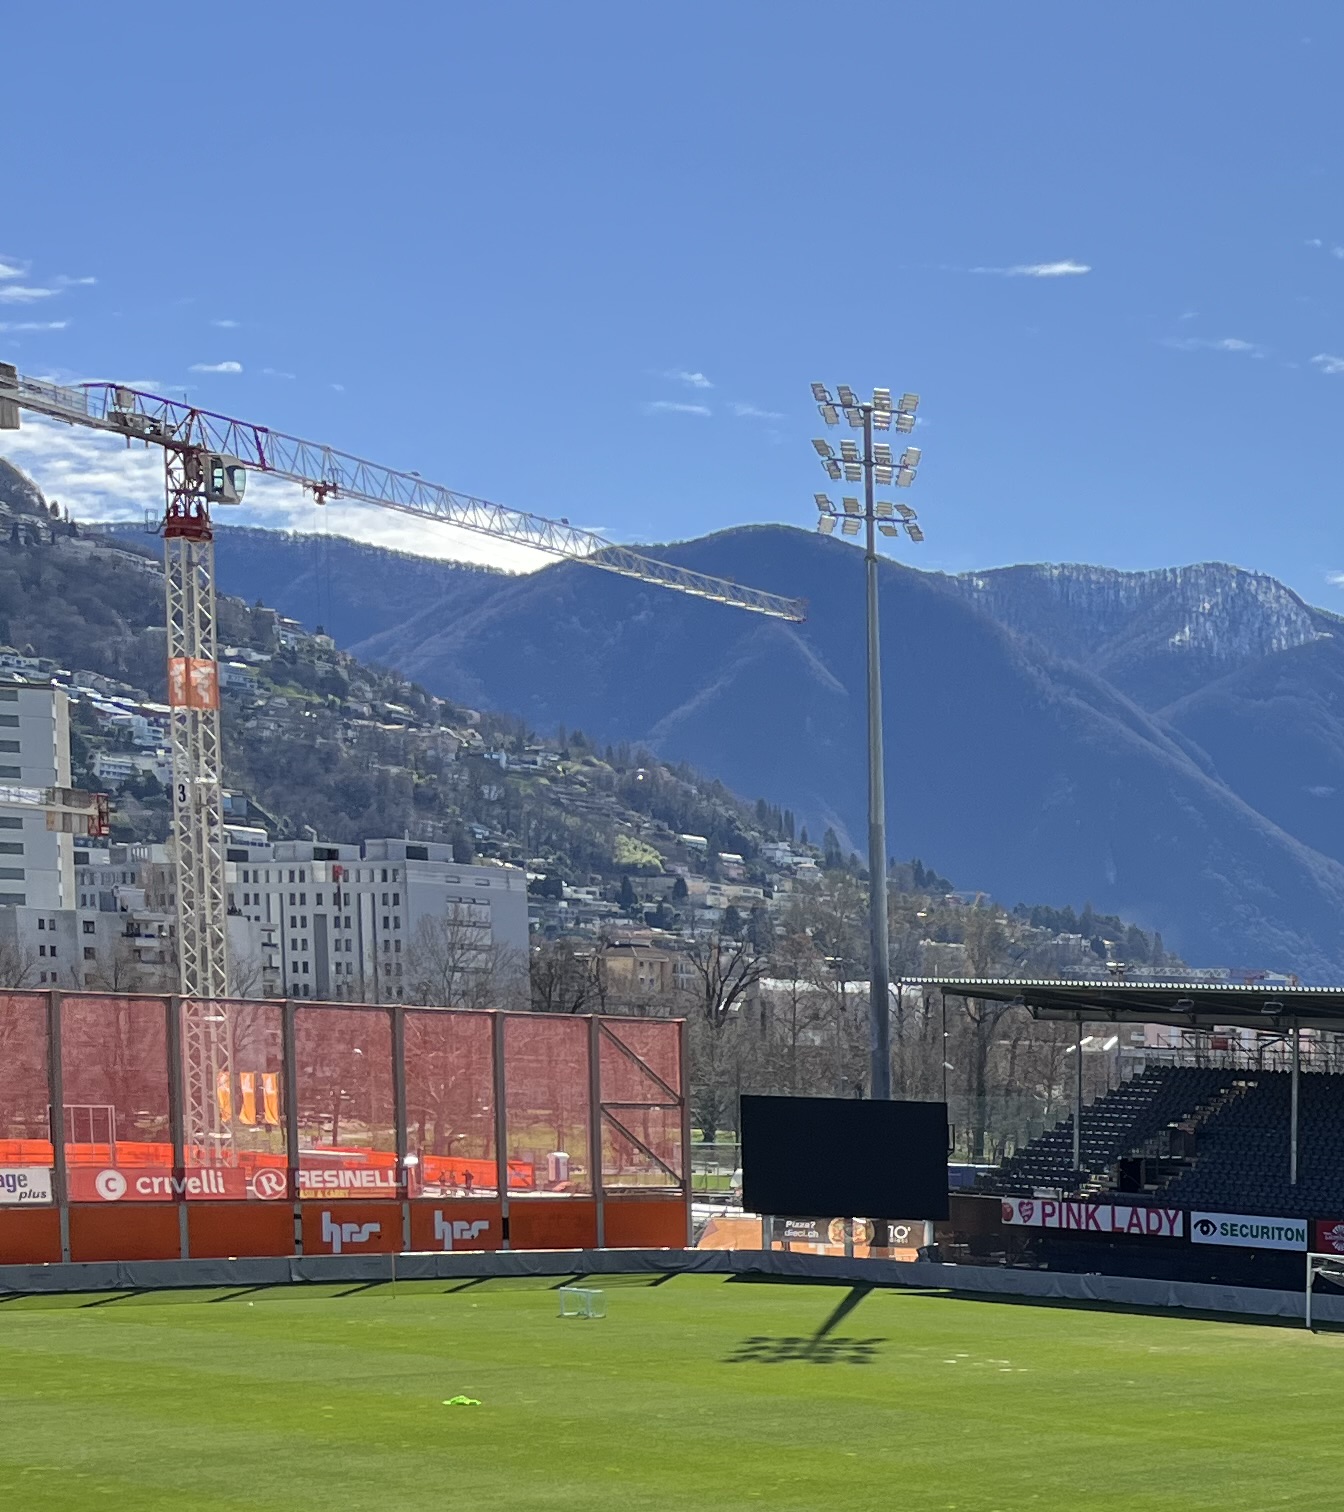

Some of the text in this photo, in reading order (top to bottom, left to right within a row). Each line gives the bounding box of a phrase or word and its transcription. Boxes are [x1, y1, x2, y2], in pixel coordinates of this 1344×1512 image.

[178, 783, 186, 802] 3
[136, 1169, 225, 1195] crivelli
[295, 1169, 408, 1189] RESINELLI
[18, 1188, 47, 1202] plus
[785, 1220, 816, 1229] Pizza?
[1041, 1201, 1182, 1237] PINK LADY
[1220, 1221, 1306, 1243] SECURITON
